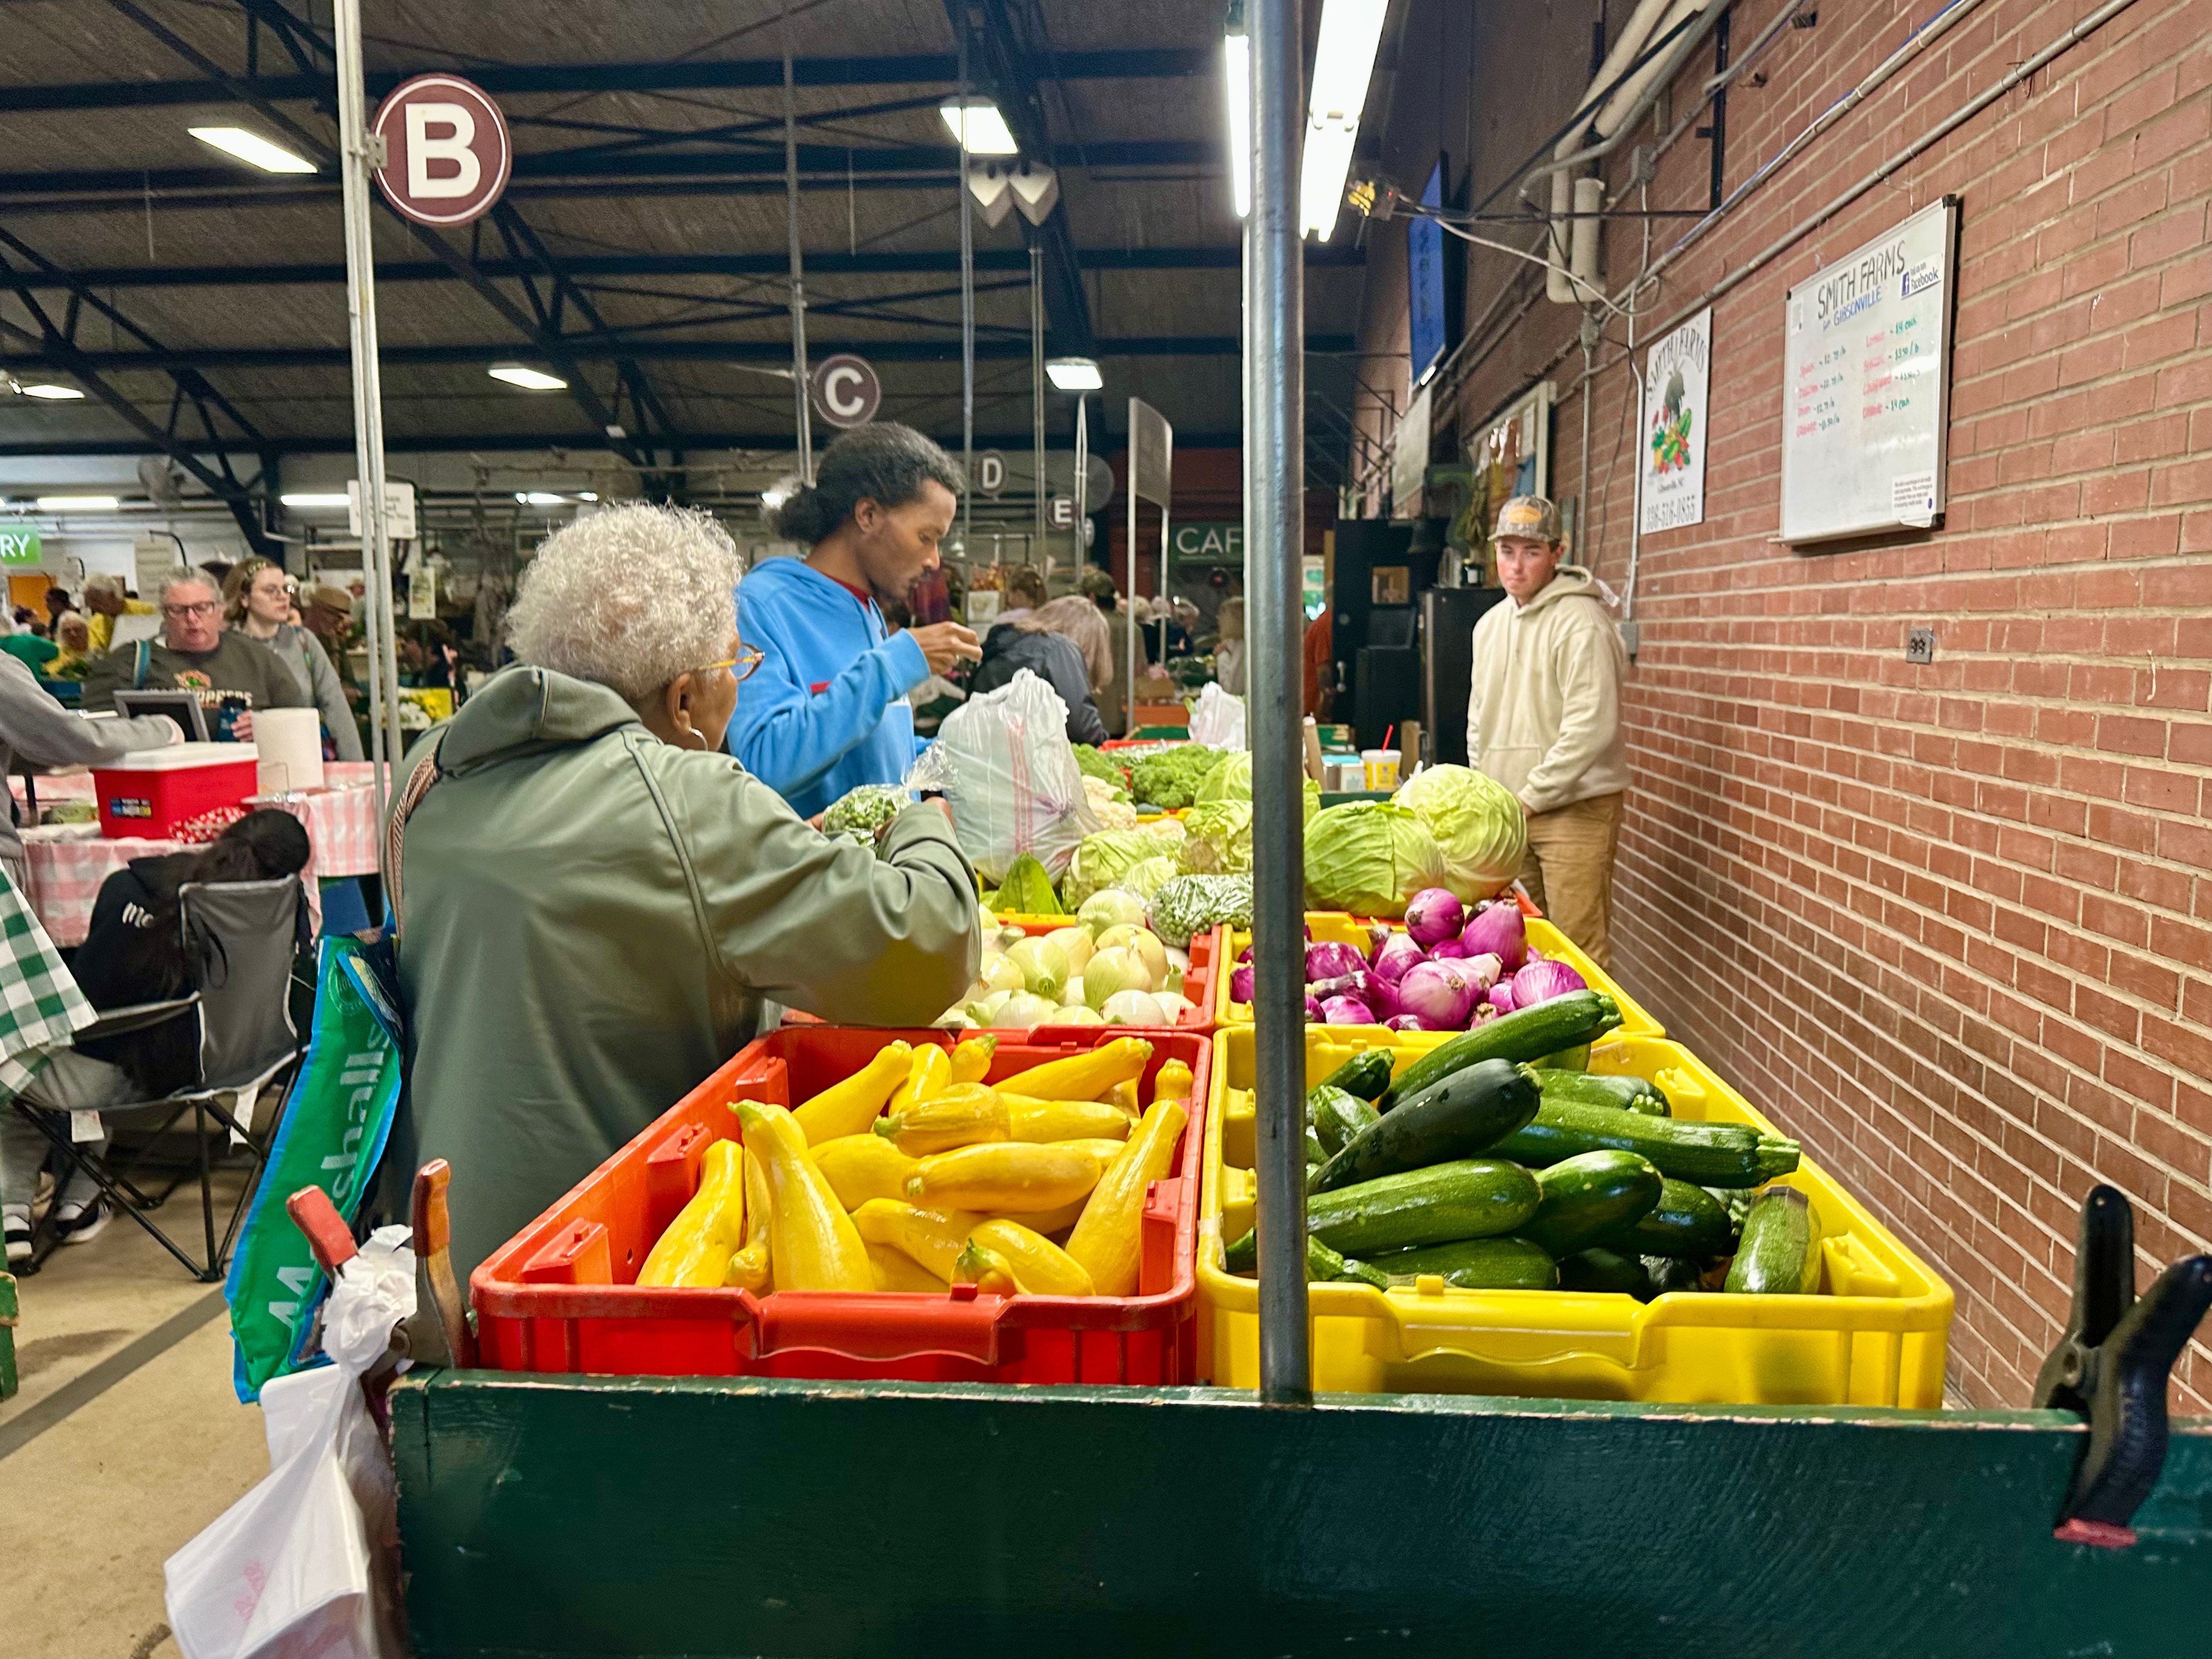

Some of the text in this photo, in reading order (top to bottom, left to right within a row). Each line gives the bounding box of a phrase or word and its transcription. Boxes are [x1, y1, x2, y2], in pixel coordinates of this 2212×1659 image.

[406, 103, 480, 198] B
[1818, 267, 1856, 319] SMITH
[1860, 240, 1905, 293] FARMS
[825, 367, 864, 416] C
[983, 458, 1003, 490] D
[1054, 499, 1073, 524] E
[0, 533, 30, 558] RY
[1176, 527, 1243, 554] CAF
